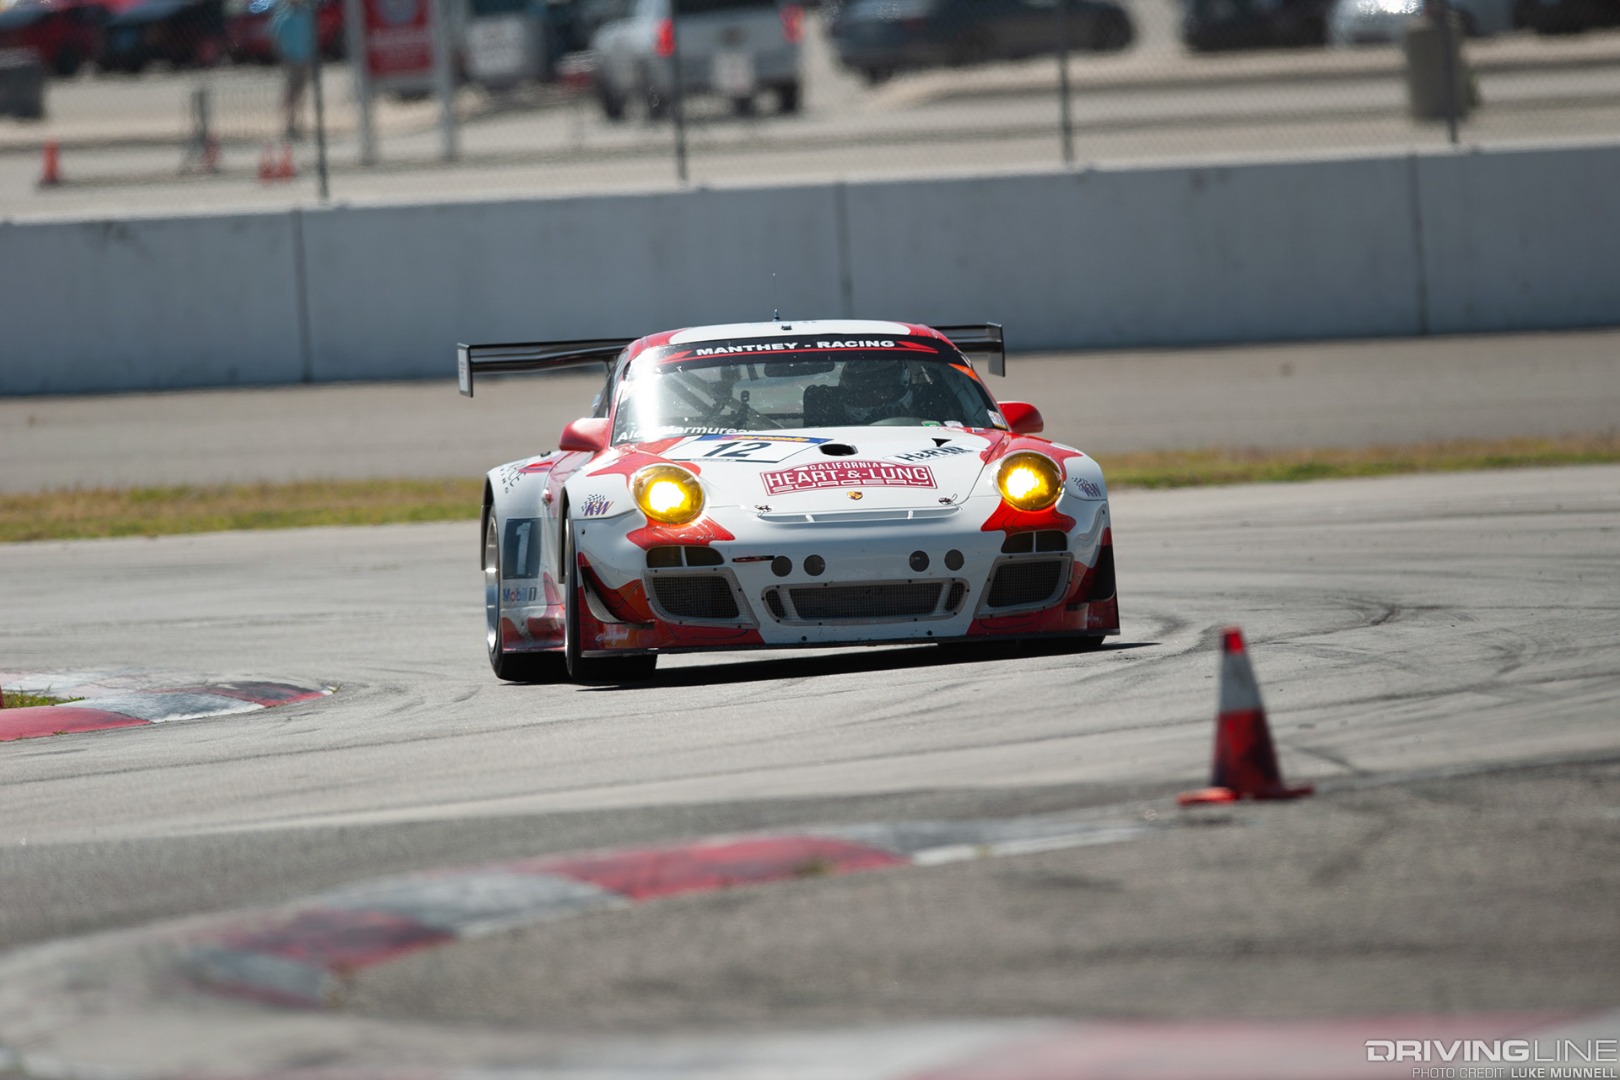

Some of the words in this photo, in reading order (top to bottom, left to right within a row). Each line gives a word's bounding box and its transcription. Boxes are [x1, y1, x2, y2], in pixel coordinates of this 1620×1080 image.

[696, 342, 798, 356] MANTHEY
[816, 340, 895, 349] RACING
[702, 441, 772, 458] 12
[809, 461, 879, 470] CALIFORNIA
[772, 479, 929, 493] SURGERY
[584, 500, 613, 517] KW
[516, 522, 531, 575] 1
[503, 586, 528, 601] Mobil
